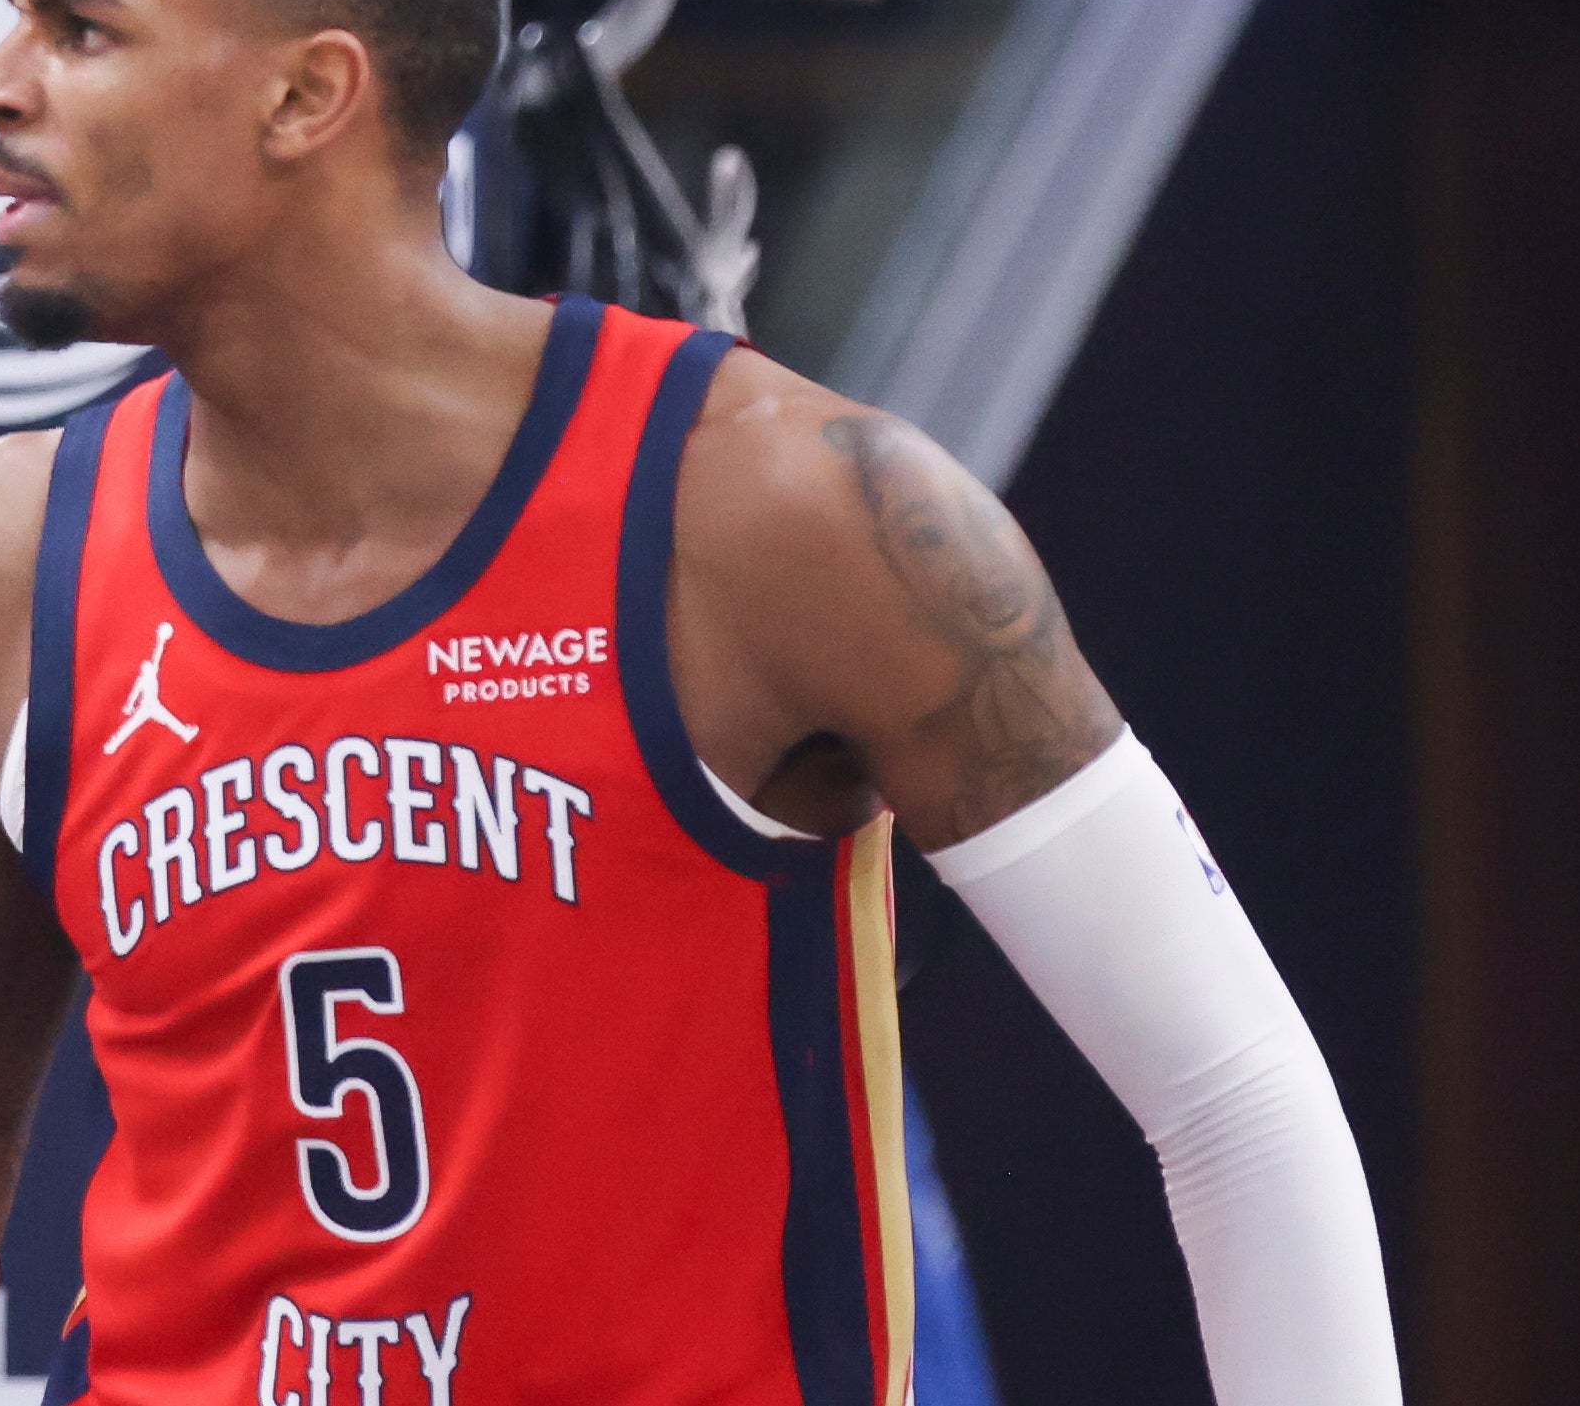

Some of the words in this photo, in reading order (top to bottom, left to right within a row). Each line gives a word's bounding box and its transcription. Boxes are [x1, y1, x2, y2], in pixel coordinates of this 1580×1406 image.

[426, 626, 608, 676] NEWAGE
[442, 672, 591, 705] PRODUCTS
[96, 736, 594, 959] CRESCENT
[279, 945, 430, 1243] 5
[258, 1292, 473, 1406] CITY
